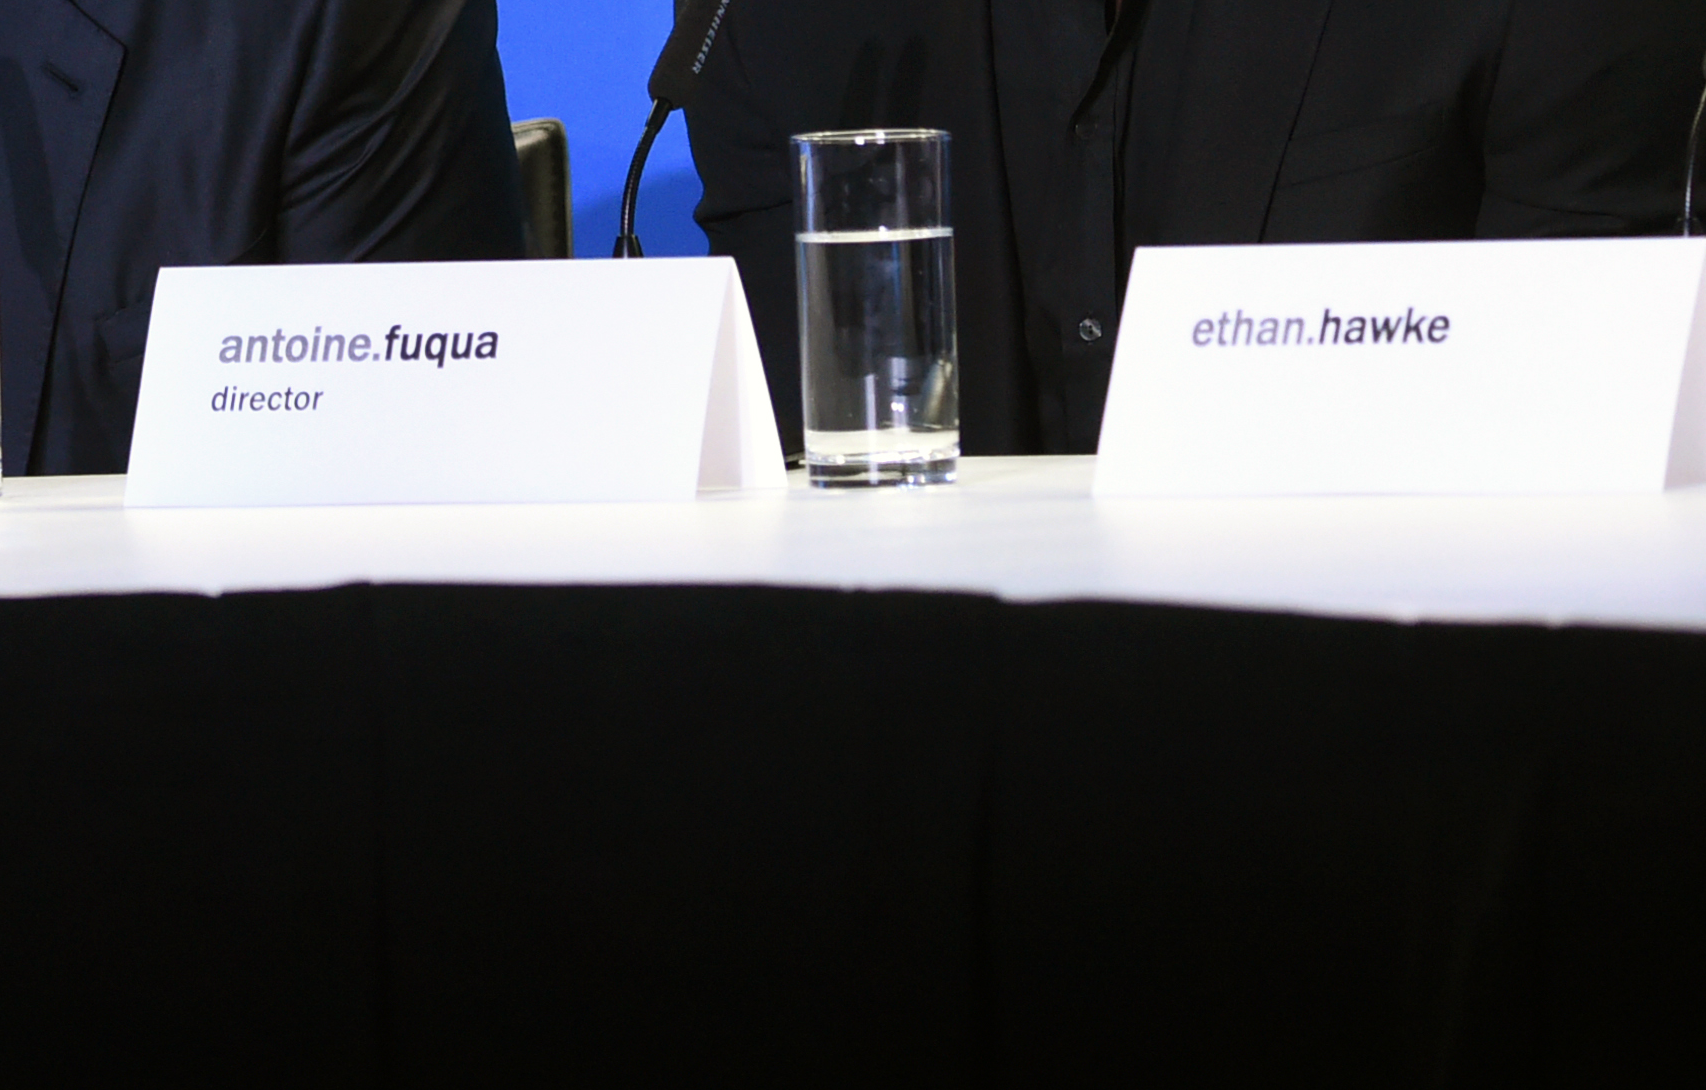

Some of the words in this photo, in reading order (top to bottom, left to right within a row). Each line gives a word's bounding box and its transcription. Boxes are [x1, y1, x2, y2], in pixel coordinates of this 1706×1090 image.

[1191, 307, 1450, 346] ethan.hawke
[218, 324, 500, 369] antoine.fuqua
[210, 386, 324, 412] director
